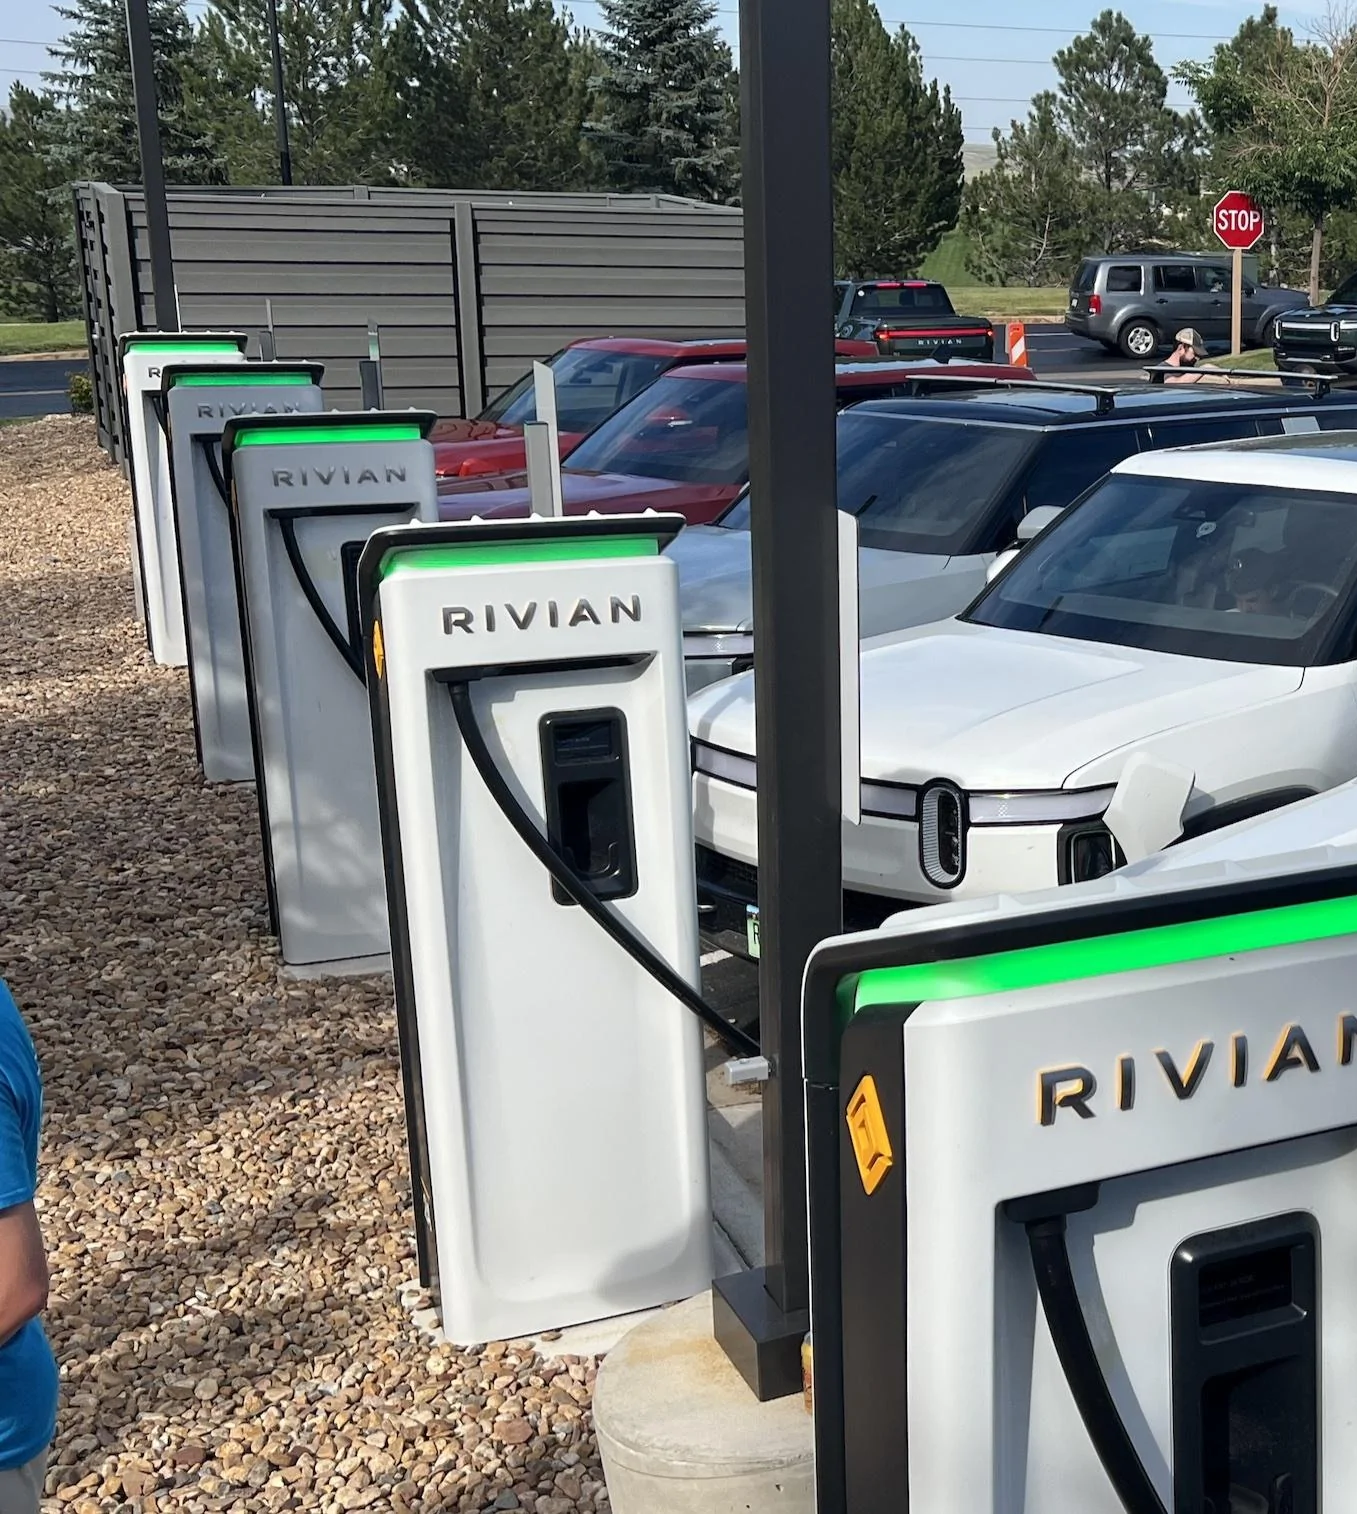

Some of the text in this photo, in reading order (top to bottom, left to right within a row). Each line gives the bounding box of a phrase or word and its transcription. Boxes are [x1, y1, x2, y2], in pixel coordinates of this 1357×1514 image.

[1217, 209, 1261, 232] STOP
[917, 338, 962, 346] RIVIAN
[271, 465, 407, 488] RIVIAN
[441, 594, 642, 635] RIVIAN
